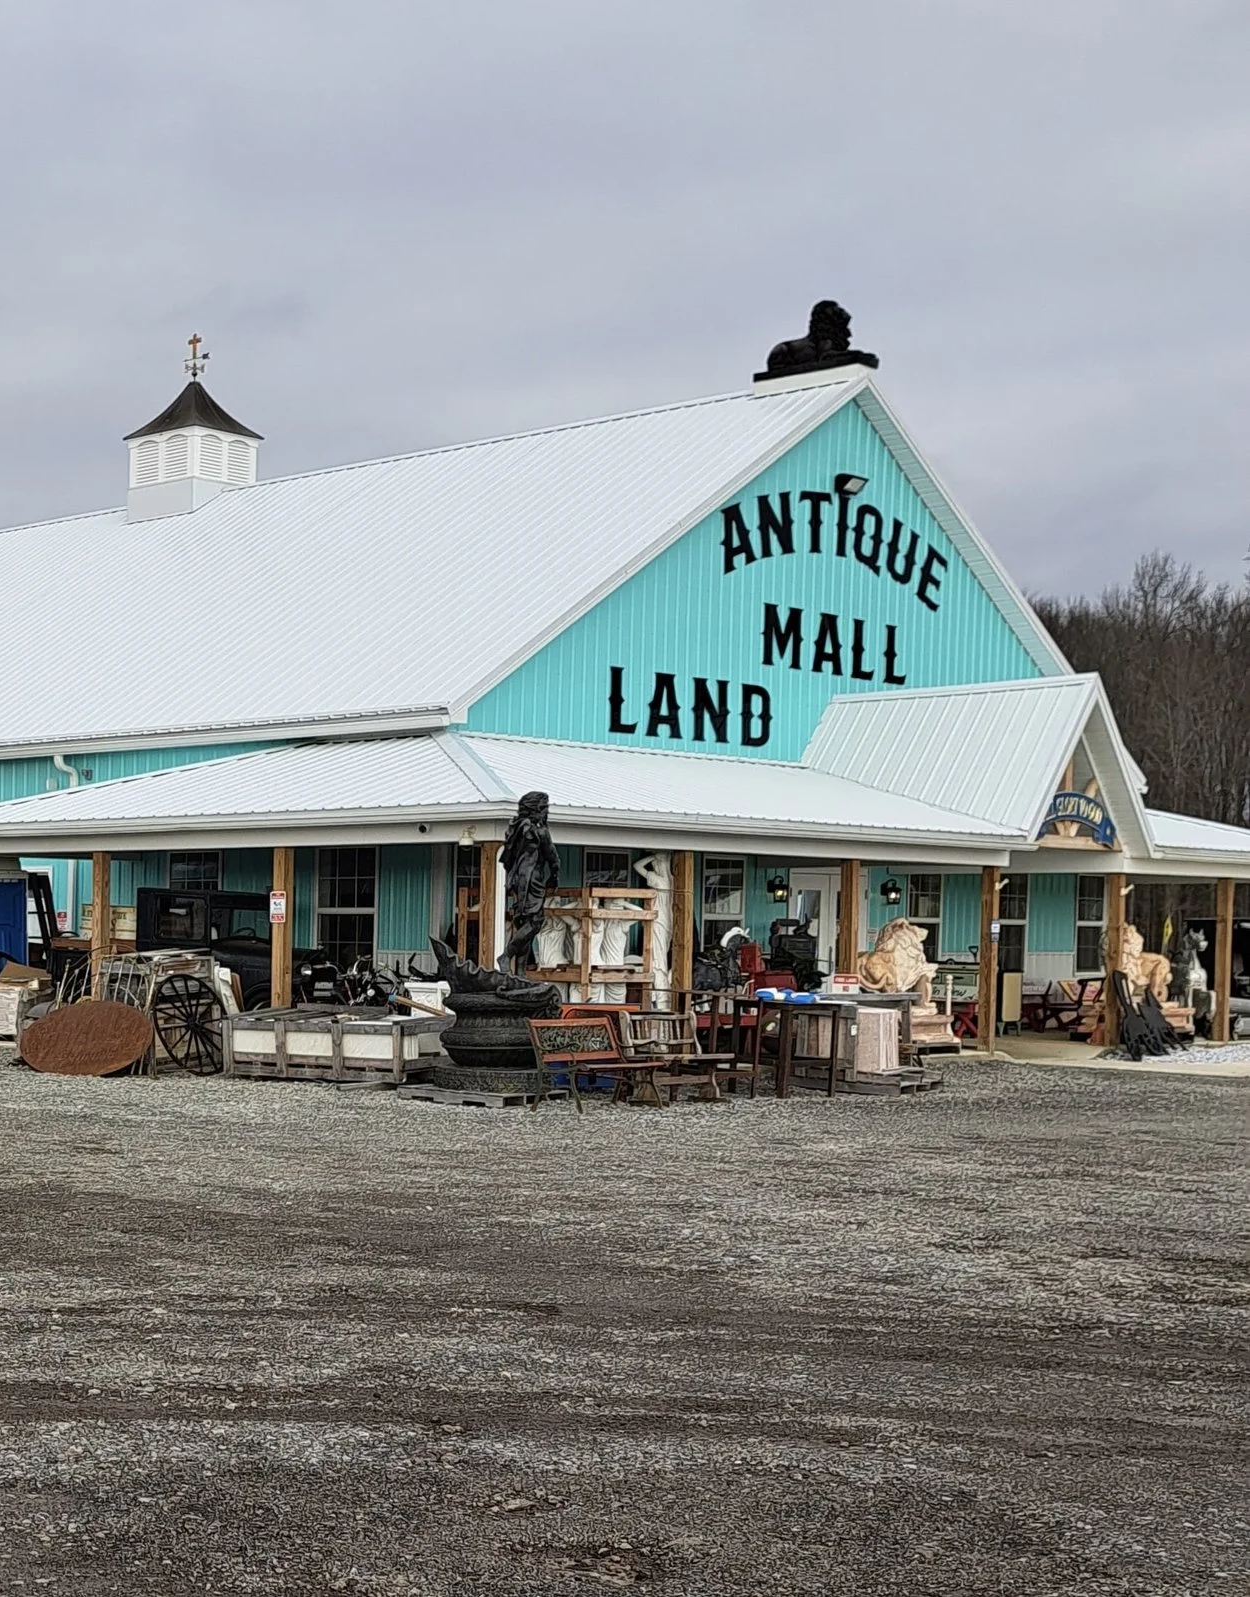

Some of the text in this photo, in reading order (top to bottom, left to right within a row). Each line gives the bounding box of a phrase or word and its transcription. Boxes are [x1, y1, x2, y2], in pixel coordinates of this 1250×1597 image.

[719, 490, 948, 612] ANTIQUE
[760, 602, 907, 685] MALL
[607, 666, 773, 747] LAND
